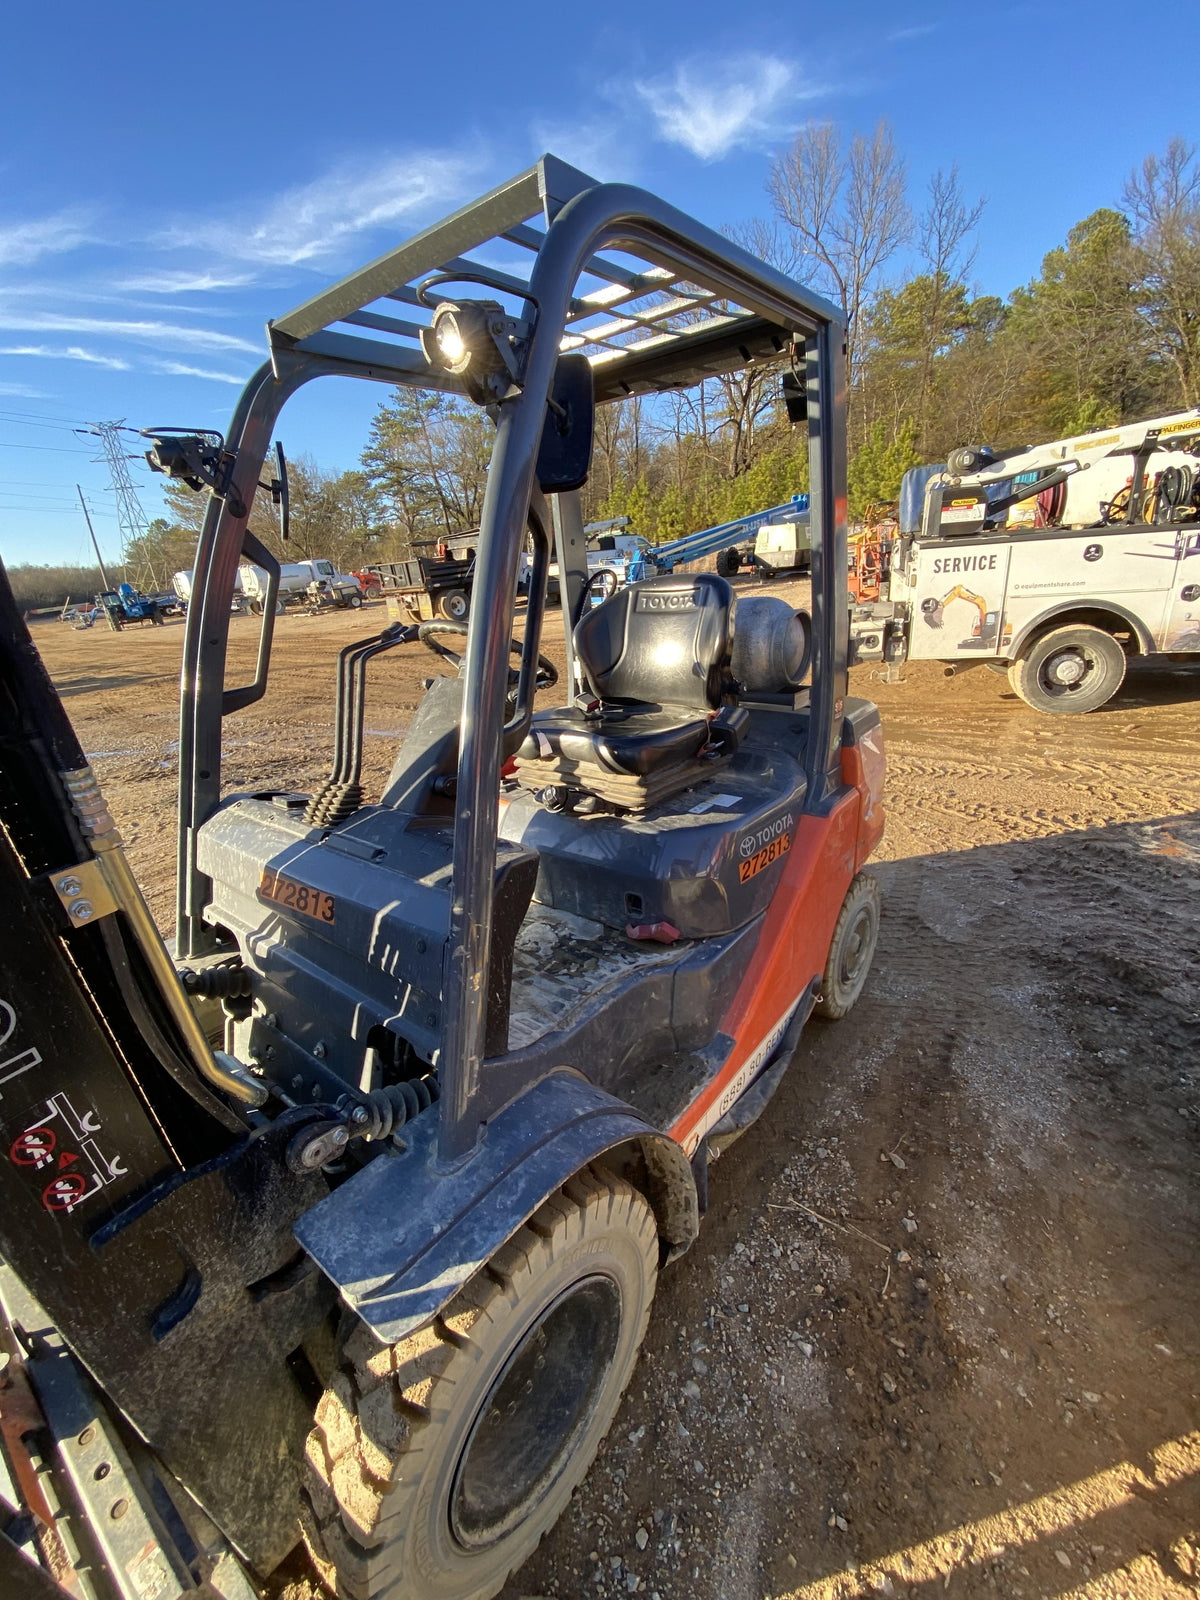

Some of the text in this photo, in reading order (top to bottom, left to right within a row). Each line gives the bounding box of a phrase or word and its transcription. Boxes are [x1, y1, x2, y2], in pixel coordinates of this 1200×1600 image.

[1160, 420, 1200, 434] PALFINGER
[933, 555, 998, 574] SERVICE
[1020, 580, 1086, 590] equipmentshare.com
[641, 595, 697, 609] TOYOTA
[756, 813, 794, 846] TOYOTA
[741, 833, 791, 882] 272813
[261, 874, 335, 921] 272813
[719, 1072, 747, 1116] (888)
